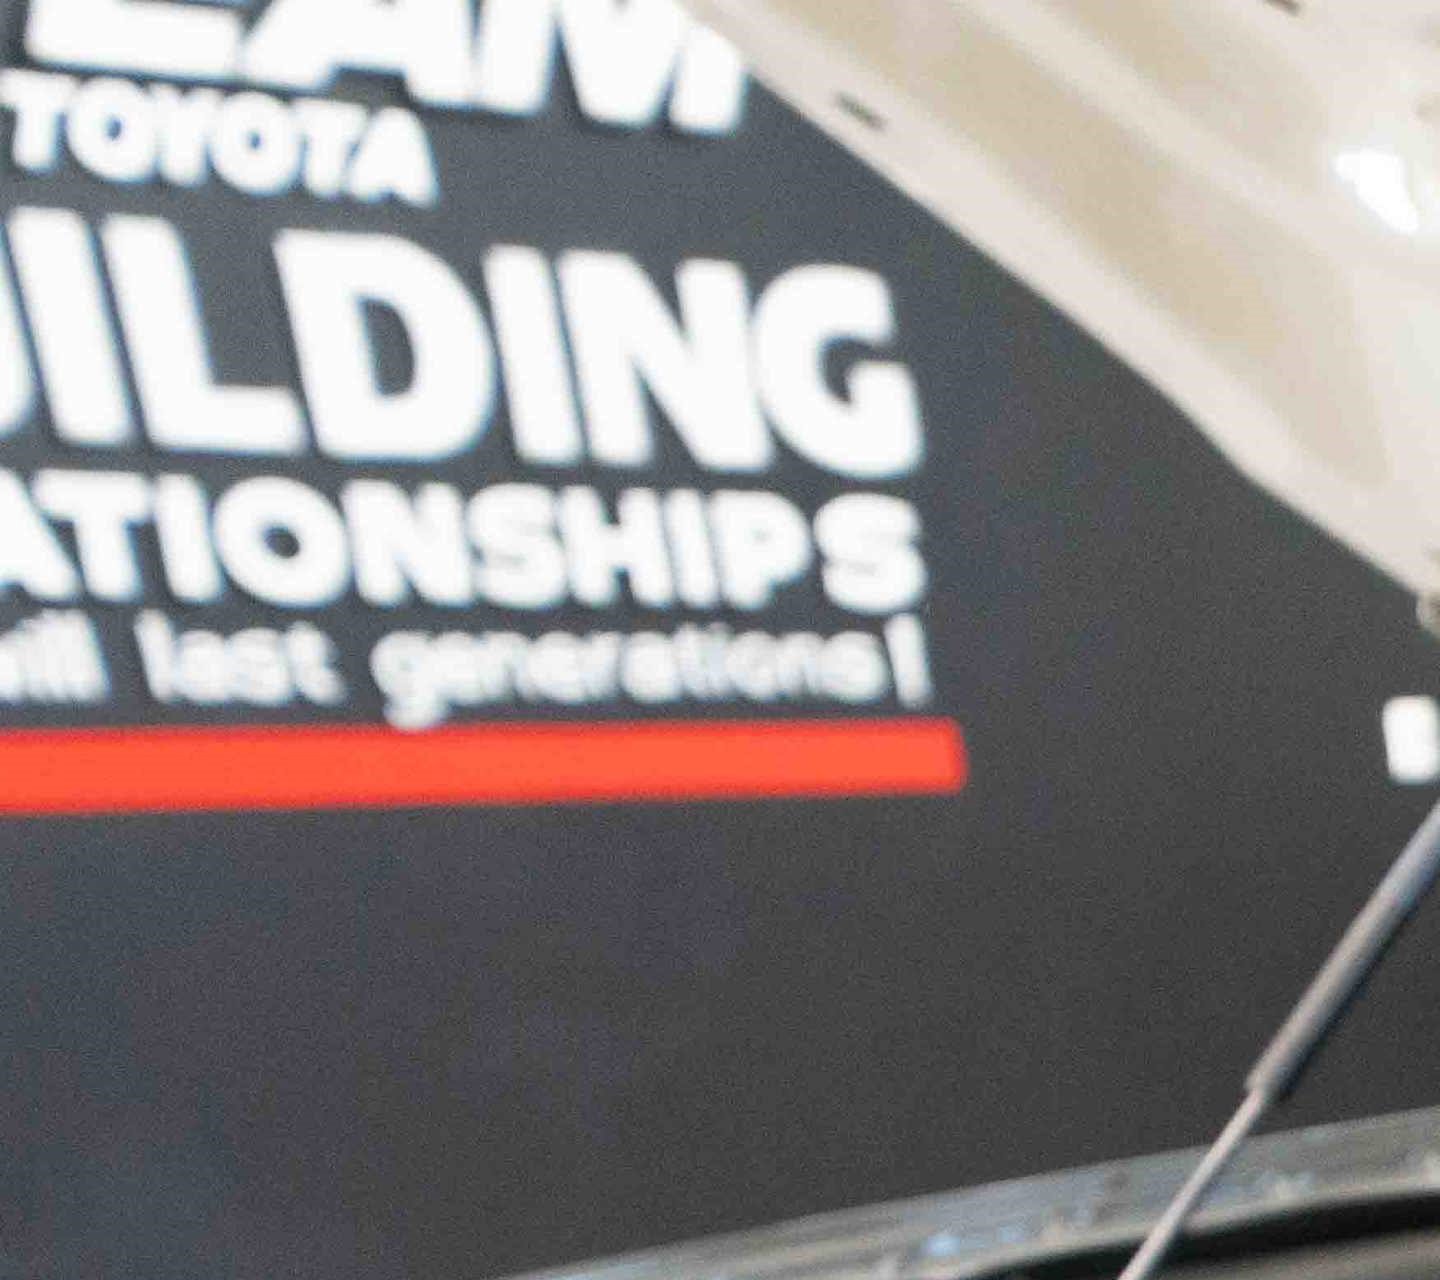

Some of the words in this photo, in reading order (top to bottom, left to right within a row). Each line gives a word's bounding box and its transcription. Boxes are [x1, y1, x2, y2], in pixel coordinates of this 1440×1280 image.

[0, 67, 438, 206] TOYOTA
[0, 206, 924, 478] ILDING
[134, 610, 342, 704] last
